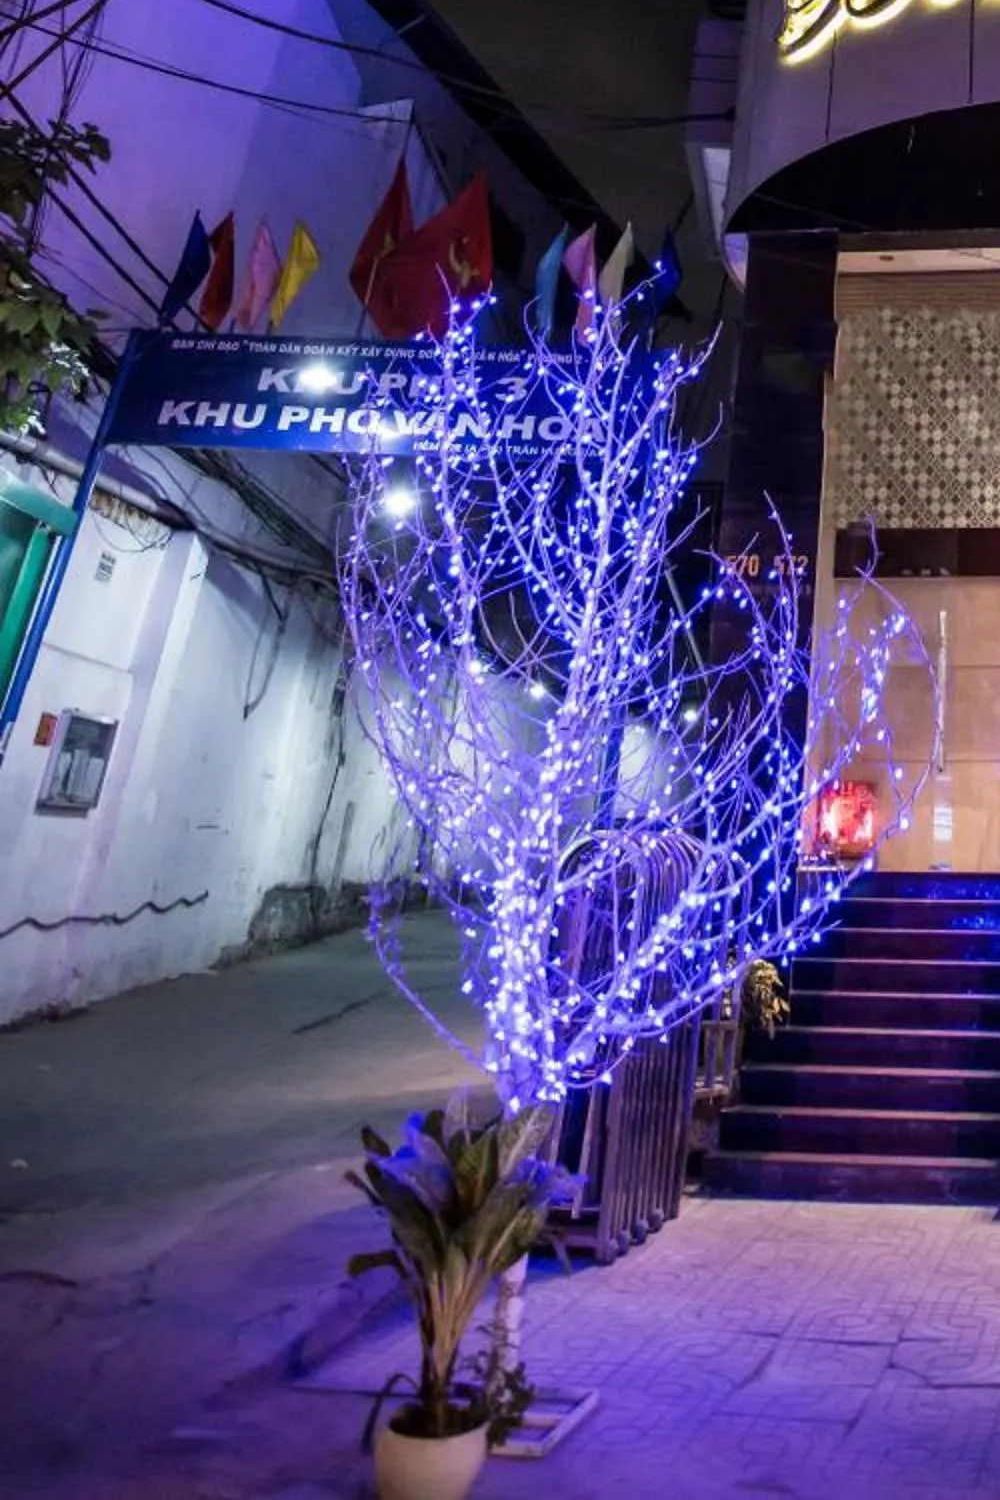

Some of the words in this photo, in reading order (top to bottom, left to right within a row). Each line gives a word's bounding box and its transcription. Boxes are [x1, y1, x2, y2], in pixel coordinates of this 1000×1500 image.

[257, 367, 370, 396] KU
[495, 376, 528, 402] 3
[157, 400, 267, 429] KHU
